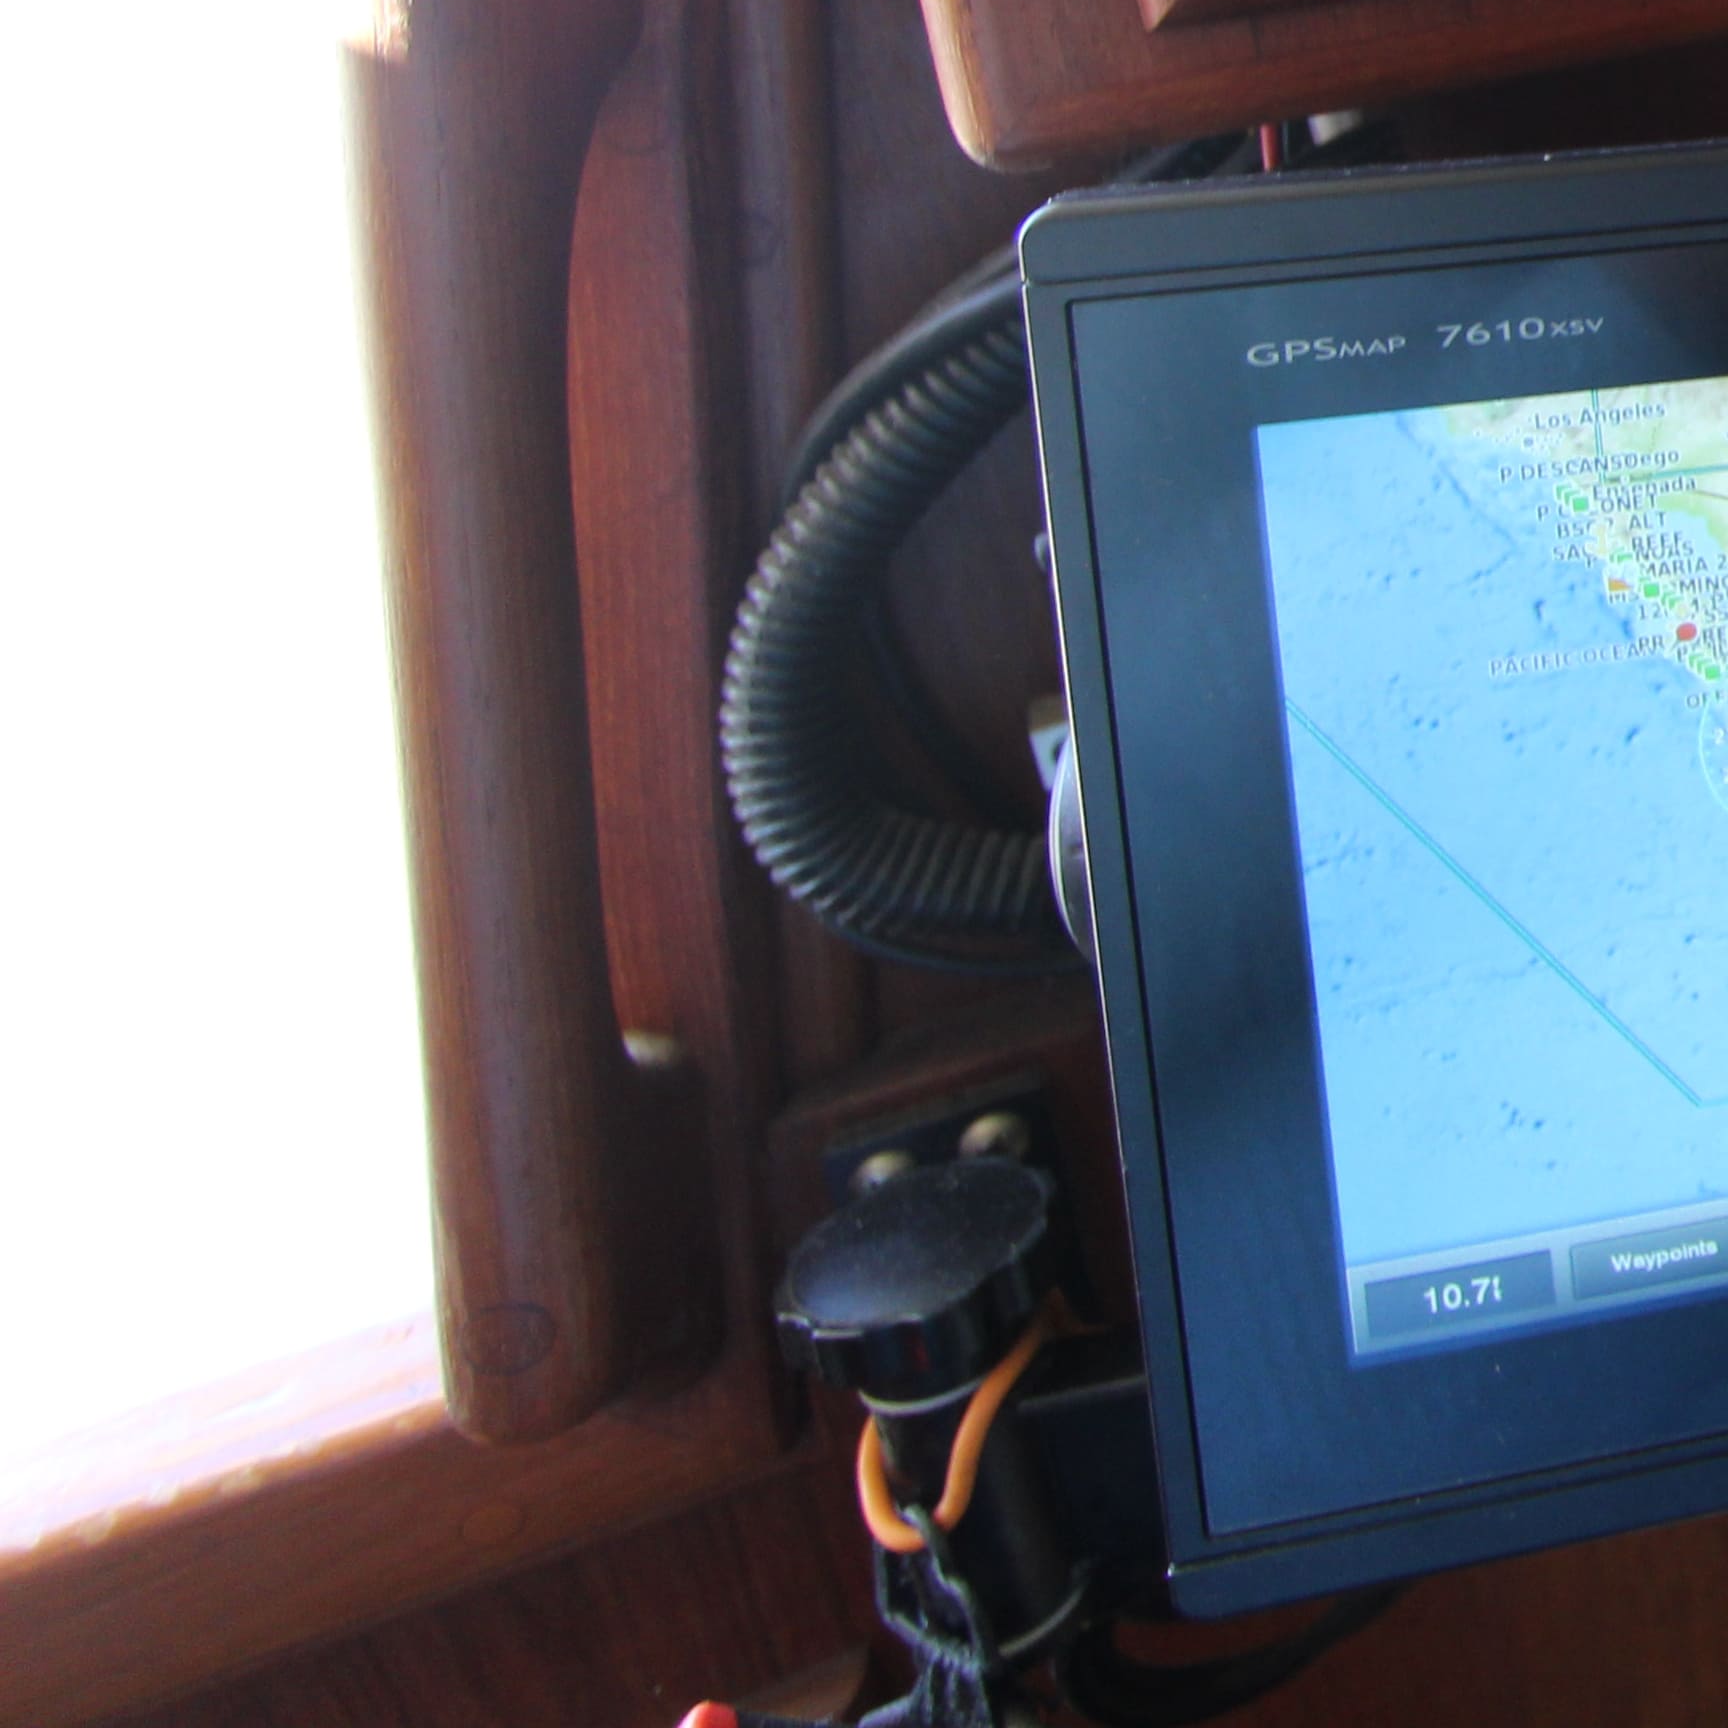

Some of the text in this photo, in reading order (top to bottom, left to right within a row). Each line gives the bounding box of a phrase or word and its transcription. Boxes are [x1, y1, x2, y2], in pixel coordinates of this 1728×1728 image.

[1535, 402, 1666, 429] Los Angeles
[1592, 475, 1698, 501] Ensenada
[1490, 651, 1572, 677] PACIFIC
[1582, 643, 1660, 663] OCEA
[1611, 1238, 1719, 1274] Waypoints
